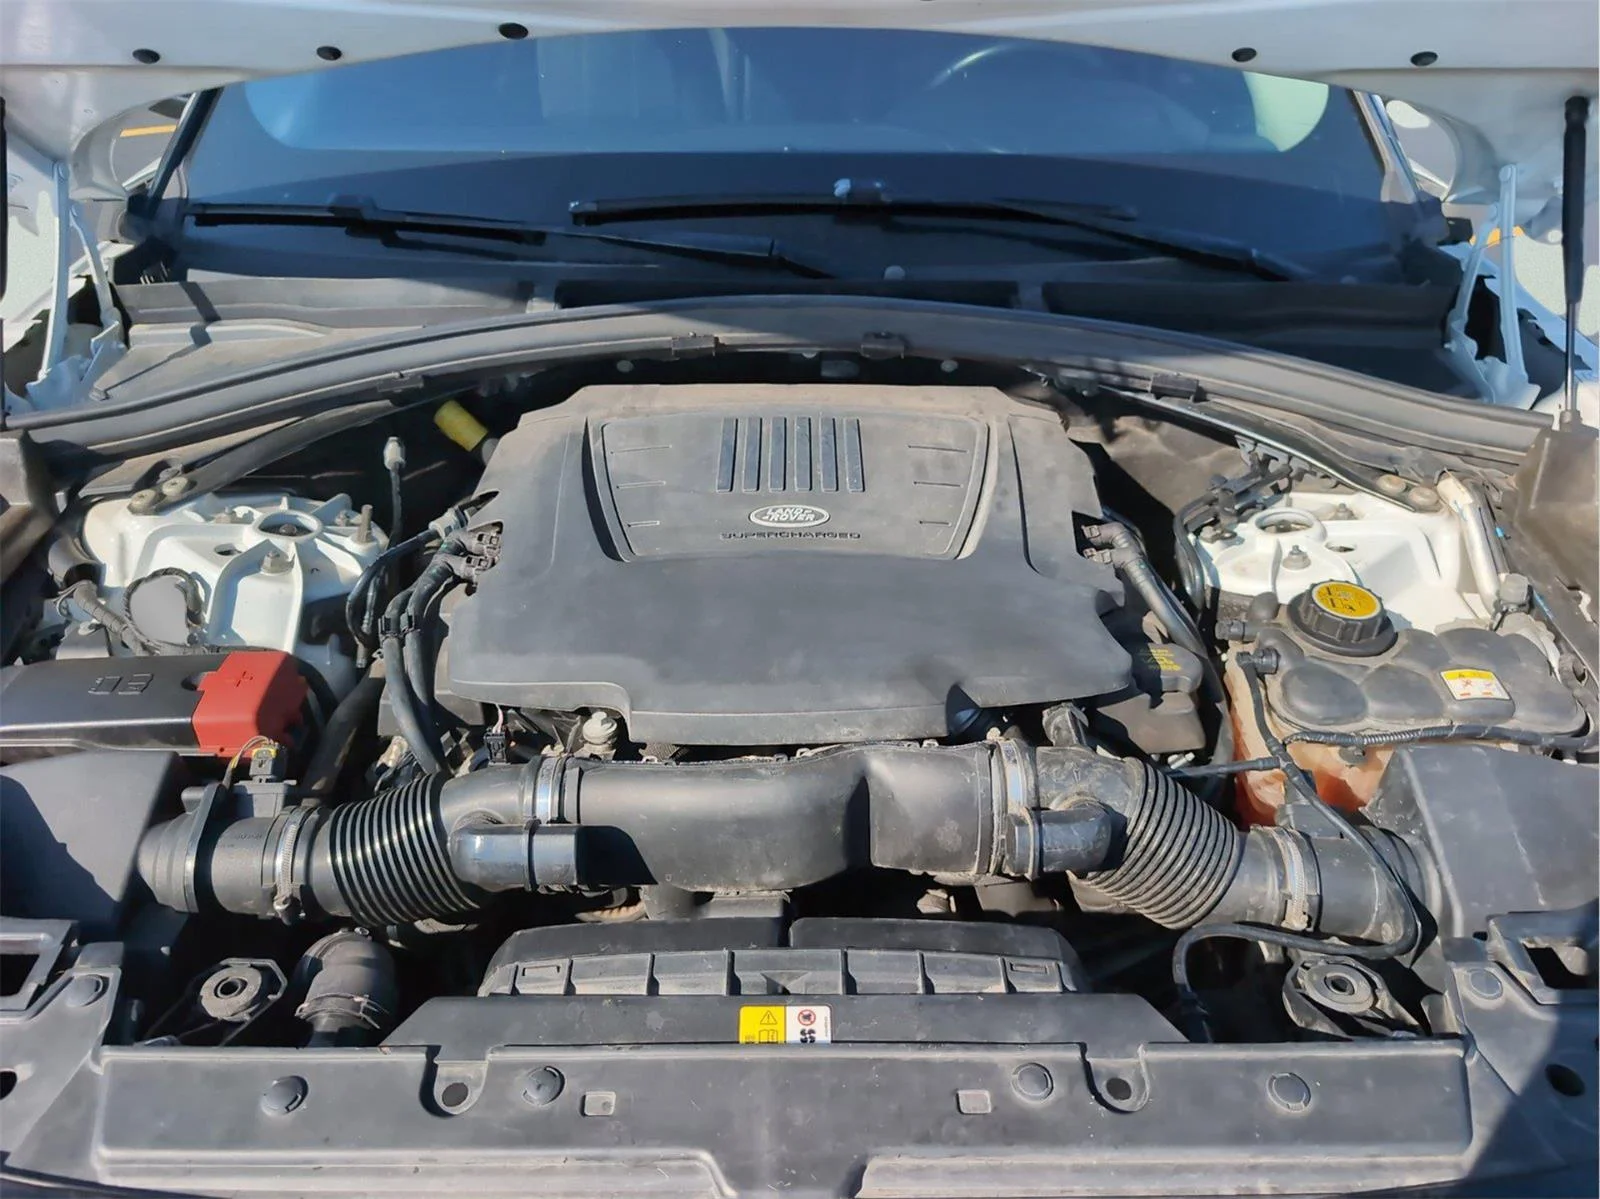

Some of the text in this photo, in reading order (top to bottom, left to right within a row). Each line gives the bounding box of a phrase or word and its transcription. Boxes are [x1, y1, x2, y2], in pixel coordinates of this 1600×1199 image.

[766, 507, 804, 515] LAND
[769, 513, 816, 522] ROVER
[721, 531, 861, 539] SUPERCHARGED
